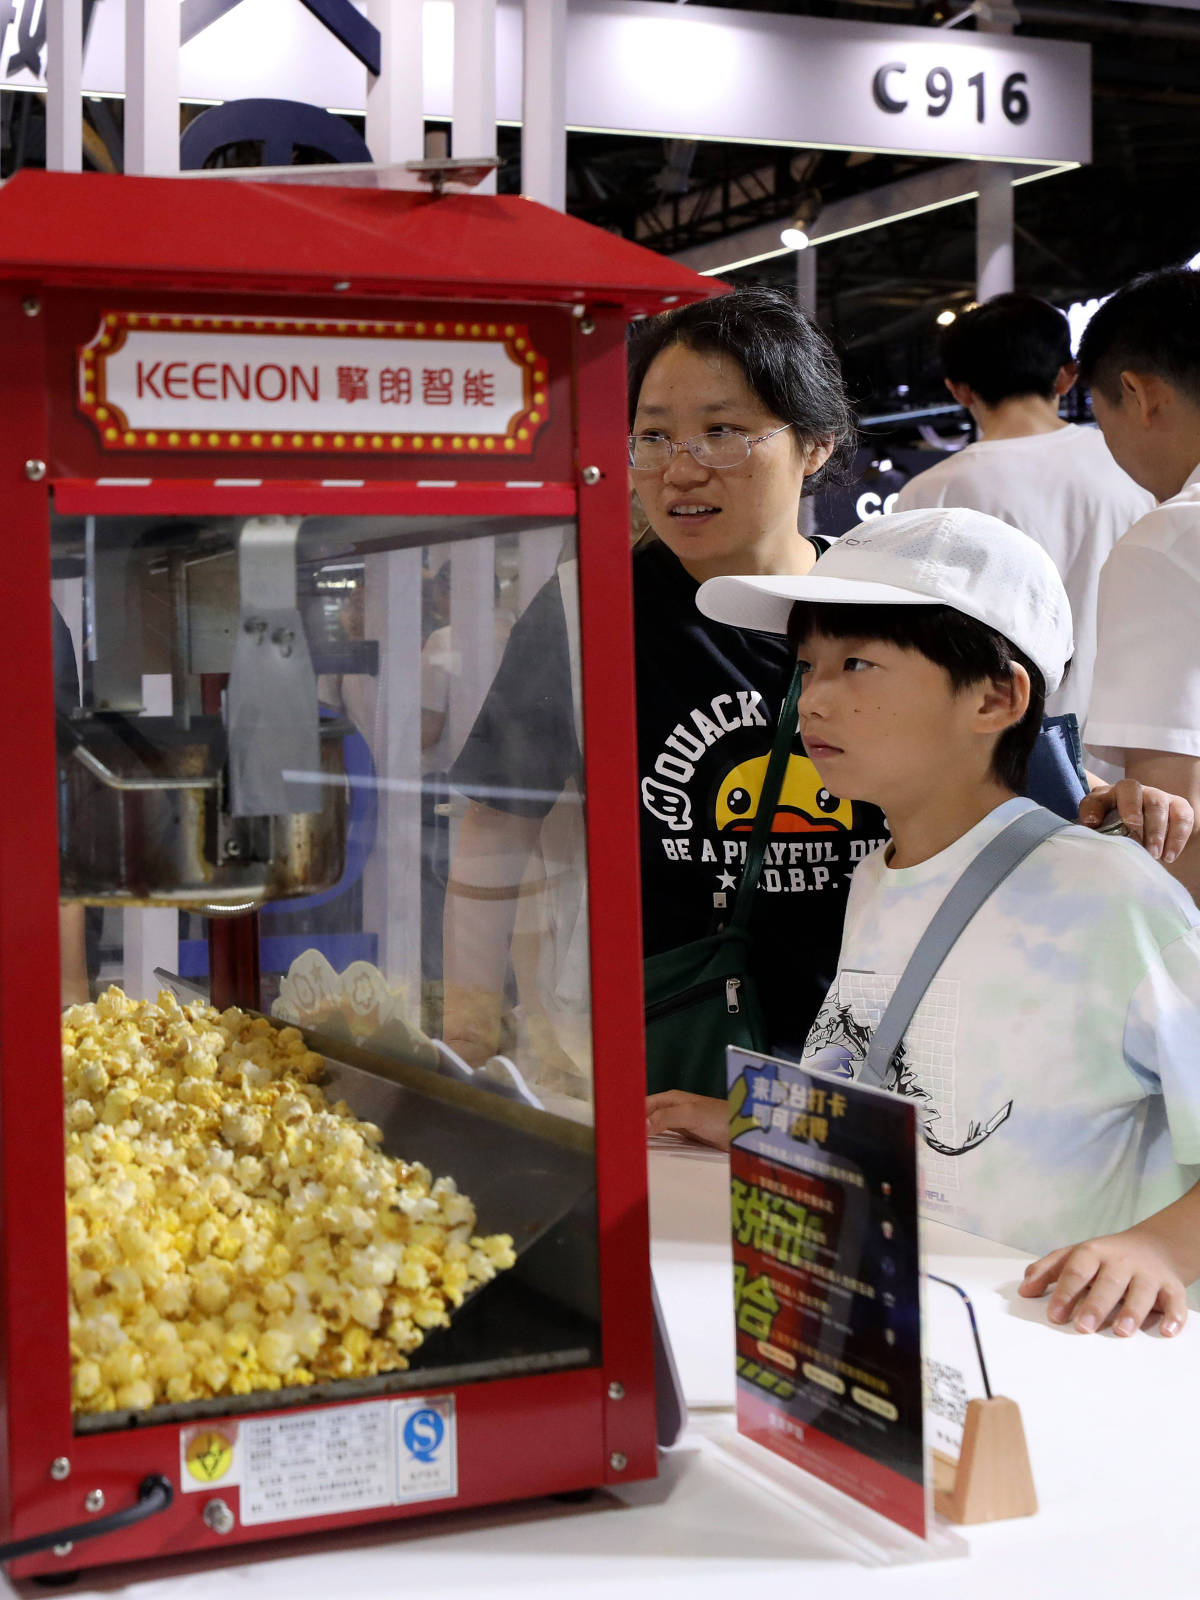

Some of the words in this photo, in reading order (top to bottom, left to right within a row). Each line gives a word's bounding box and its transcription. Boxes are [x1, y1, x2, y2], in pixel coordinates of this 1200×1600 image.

[137, 360, 319, 402] KEENON
[337, 366, 495, 406] 擎朗智能
[655, 690, 767, 783] QUACK
[662, 838, 693, 861] BE
[701, 838, 718, 862] A
